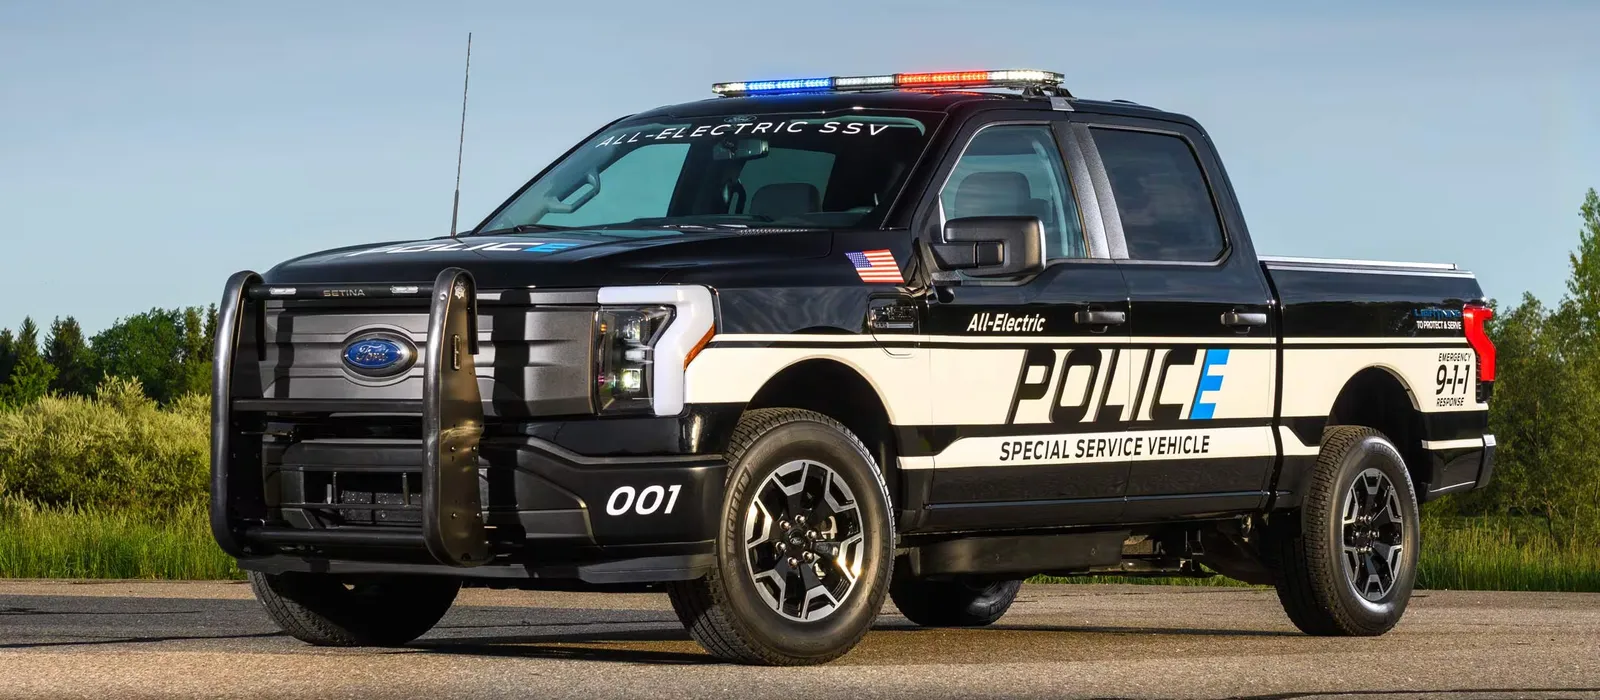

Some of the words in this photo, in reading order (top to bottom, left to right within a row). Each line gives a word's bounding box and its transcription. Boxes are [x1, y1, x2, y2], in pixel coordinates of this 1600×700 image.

[595, 121, 816, 148] ALL-ELECTRIC
[818, 121, 889, 136] SSV
[323, 289, 365, 297] SETINA
[966, 313, 1046, 332] All-Electric
[1416, 320, 1424, 329] TO
[1423, 320, 1444, 329] PROTECT
[1443, 321, 1447, 329] &
[1447, 321, 1462, 329] SERVE
[1438, 352, 1472, 362] EMERGENCY
[1005, 348, 1230, 424] POLICE
[1435, 364, 1471, 395] 9-1-1
[1436, 397, 1465, 407] RESPONSE
[999, 439, 1070, 461] SPECIAL
[1075, 437, 1143, 458] SERVICE
[1148, 435, 1211, 455] VEHICLE
[606, 484, 682, 516] 001
[727, 470, 750, 554] MICHELIN
